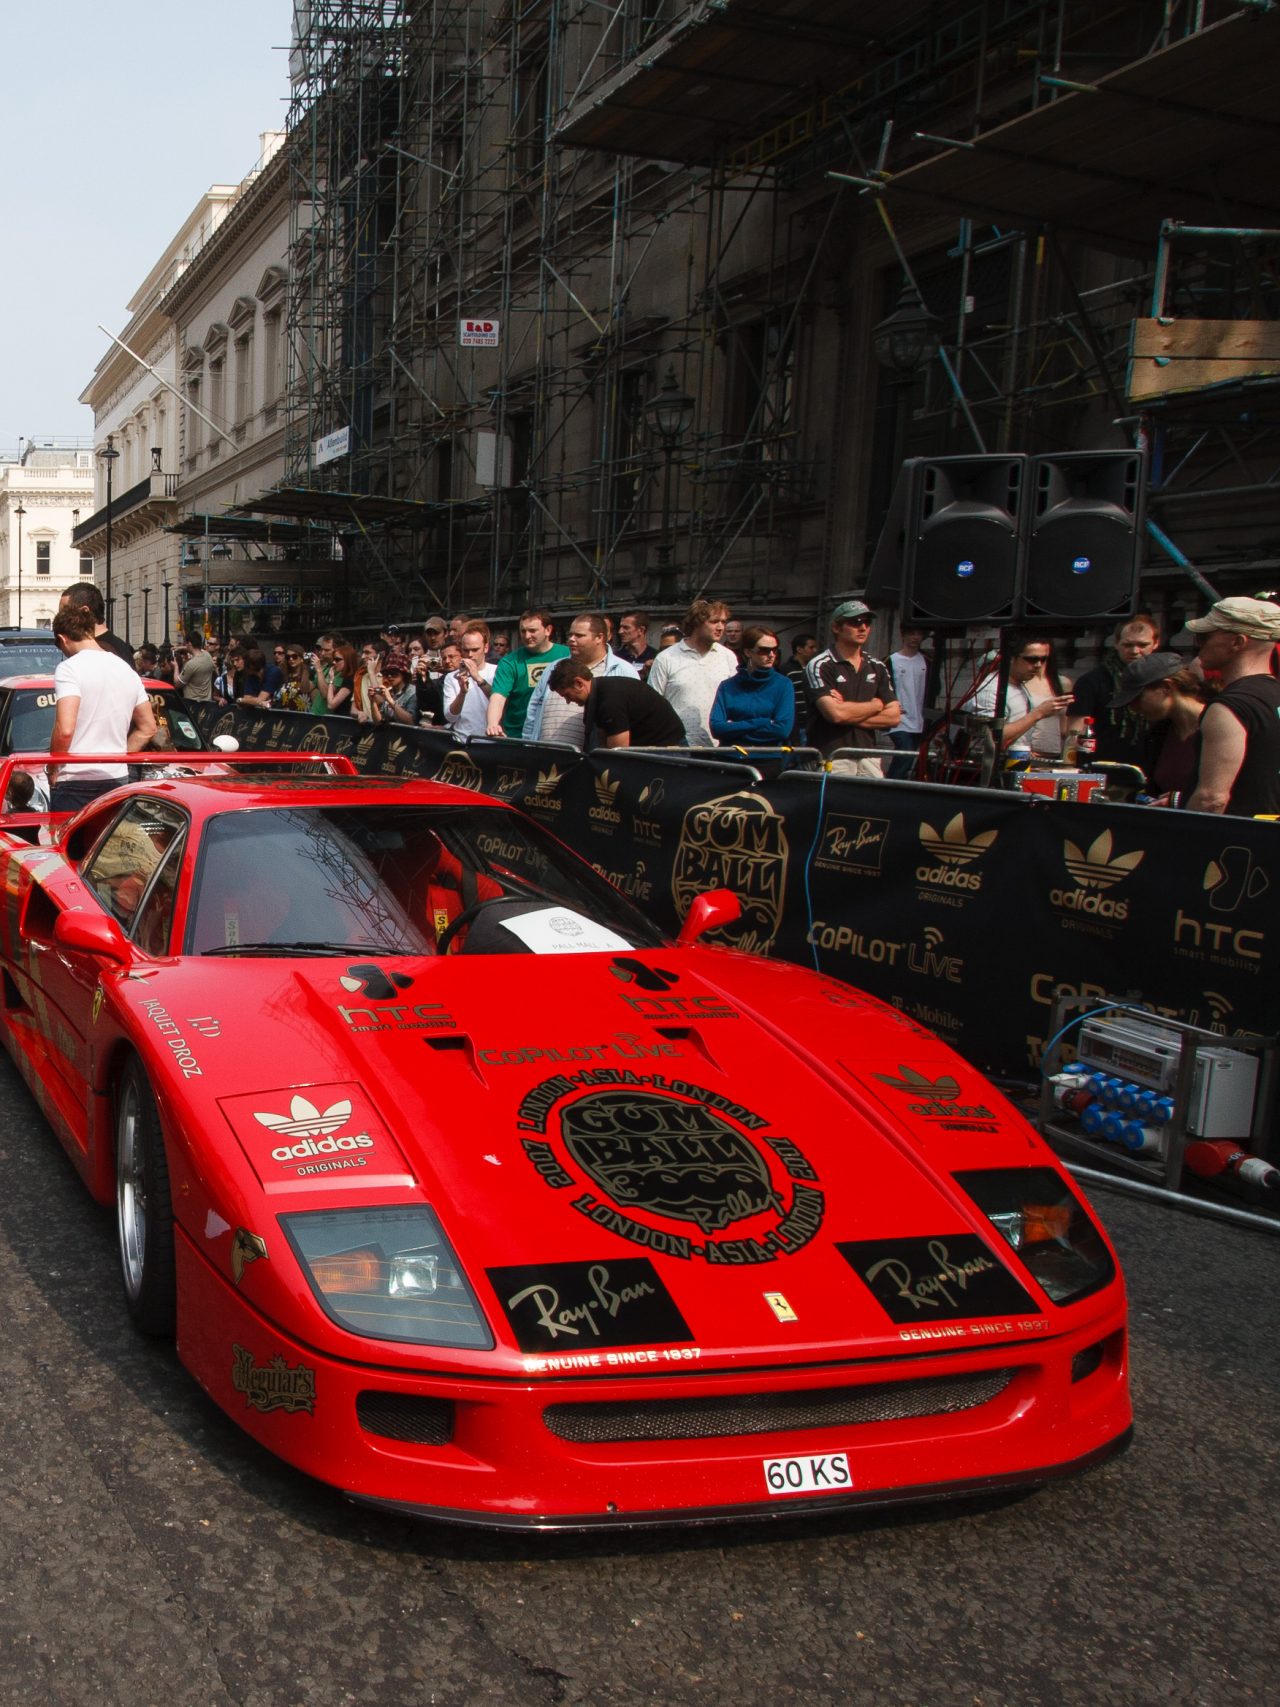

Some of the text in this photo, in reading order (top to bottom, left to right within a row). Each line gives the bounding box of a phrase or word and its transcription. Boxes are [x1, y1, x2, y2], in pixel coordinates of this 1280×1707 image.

[524, 795, 562, 811] adidas
[589, 805, 620, 824] adidas
[915, 865, 982, 890] adidas
[917, 891, 965, 908] ORIGINALS
[1049, 888, 1129, 920] adidas
[1173, 947, 1261, 975] smart mobility
[137, 998, 203, 1079] JAQUET DROZ
[351, 1024, 392, 1033] smart
[907, 1102, 997, 1119] adidas
[518, 1068, 820, 1182] LONDON ASIA LONDON 2007
[271, 1134, 374, 1162] adidas
[297, 1157, 368, 1176] ORIGINALS
[522, 1138, 576, 1189] 2007
[571, 1183, 825, 1265] LONDON ASIA LONDON
[686, 1189, 784, 1236] Rally
[900, 1319, 1050, 1341] GENUINE SINCE 1937
[524, 1347, 701, 1372] GENUINE SINCE 1937
[768, 1457, 849, 1489] 60 KS
